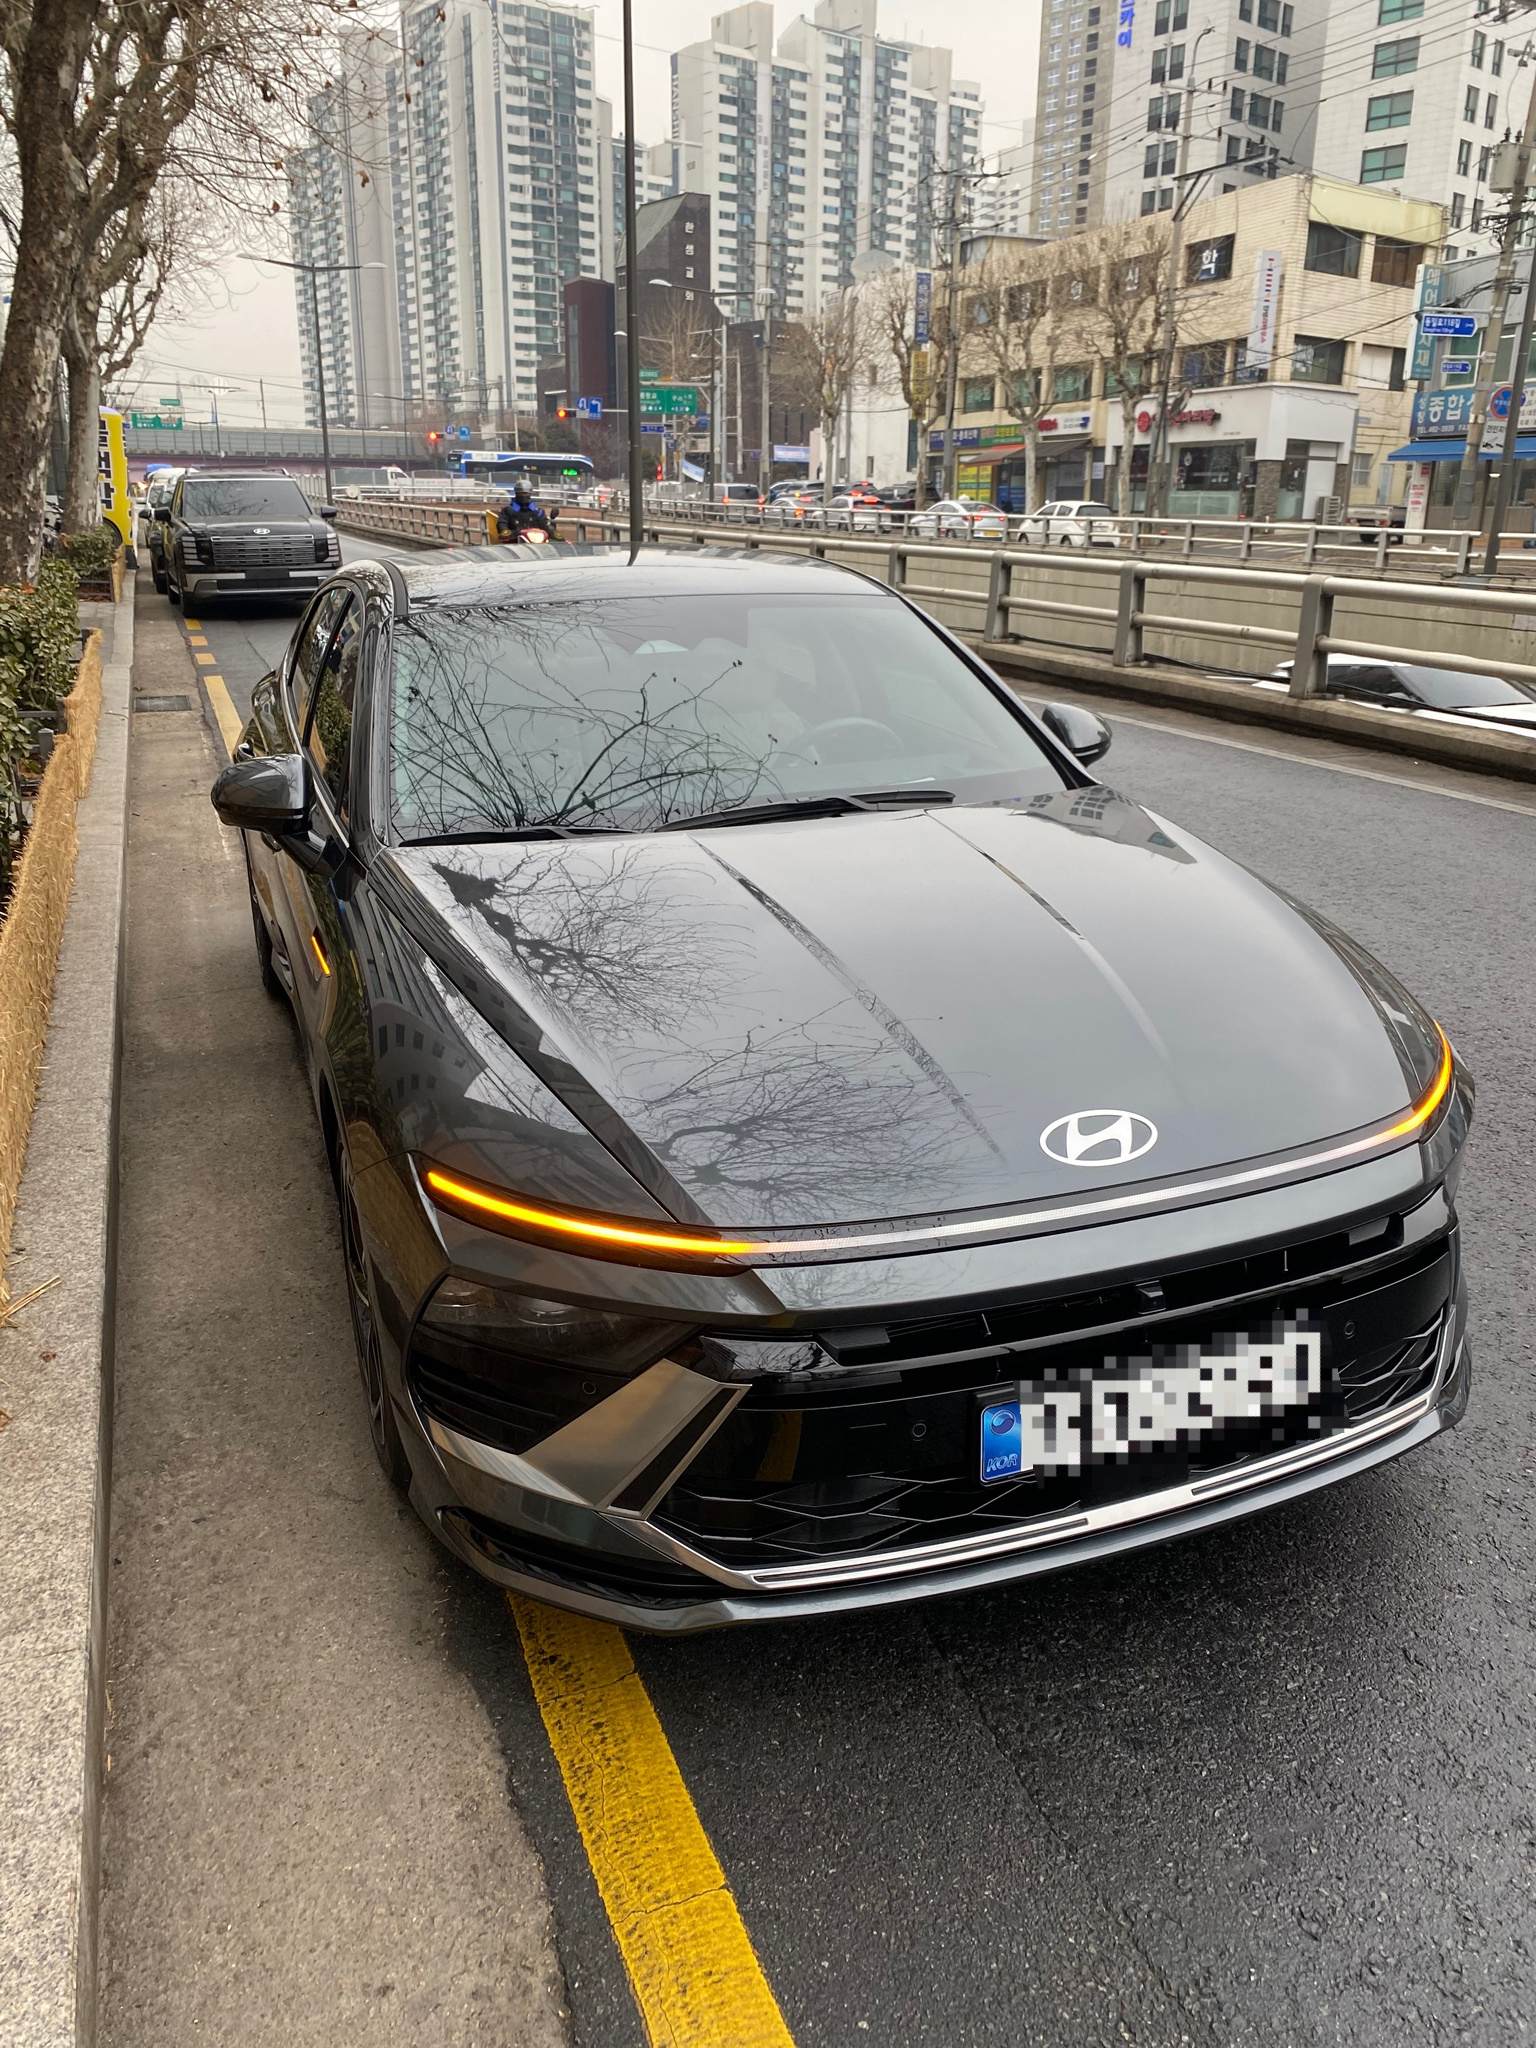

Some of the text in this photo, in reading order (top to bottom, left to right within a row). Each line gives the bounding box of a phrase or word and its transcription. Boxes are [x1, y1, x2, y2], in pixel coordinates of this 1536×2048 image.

[1416, 268, 1441, 367] 에어자재
[1487, 425, 1504, 434] 견인지
[986, 1453, 1018, 1473] KOR
